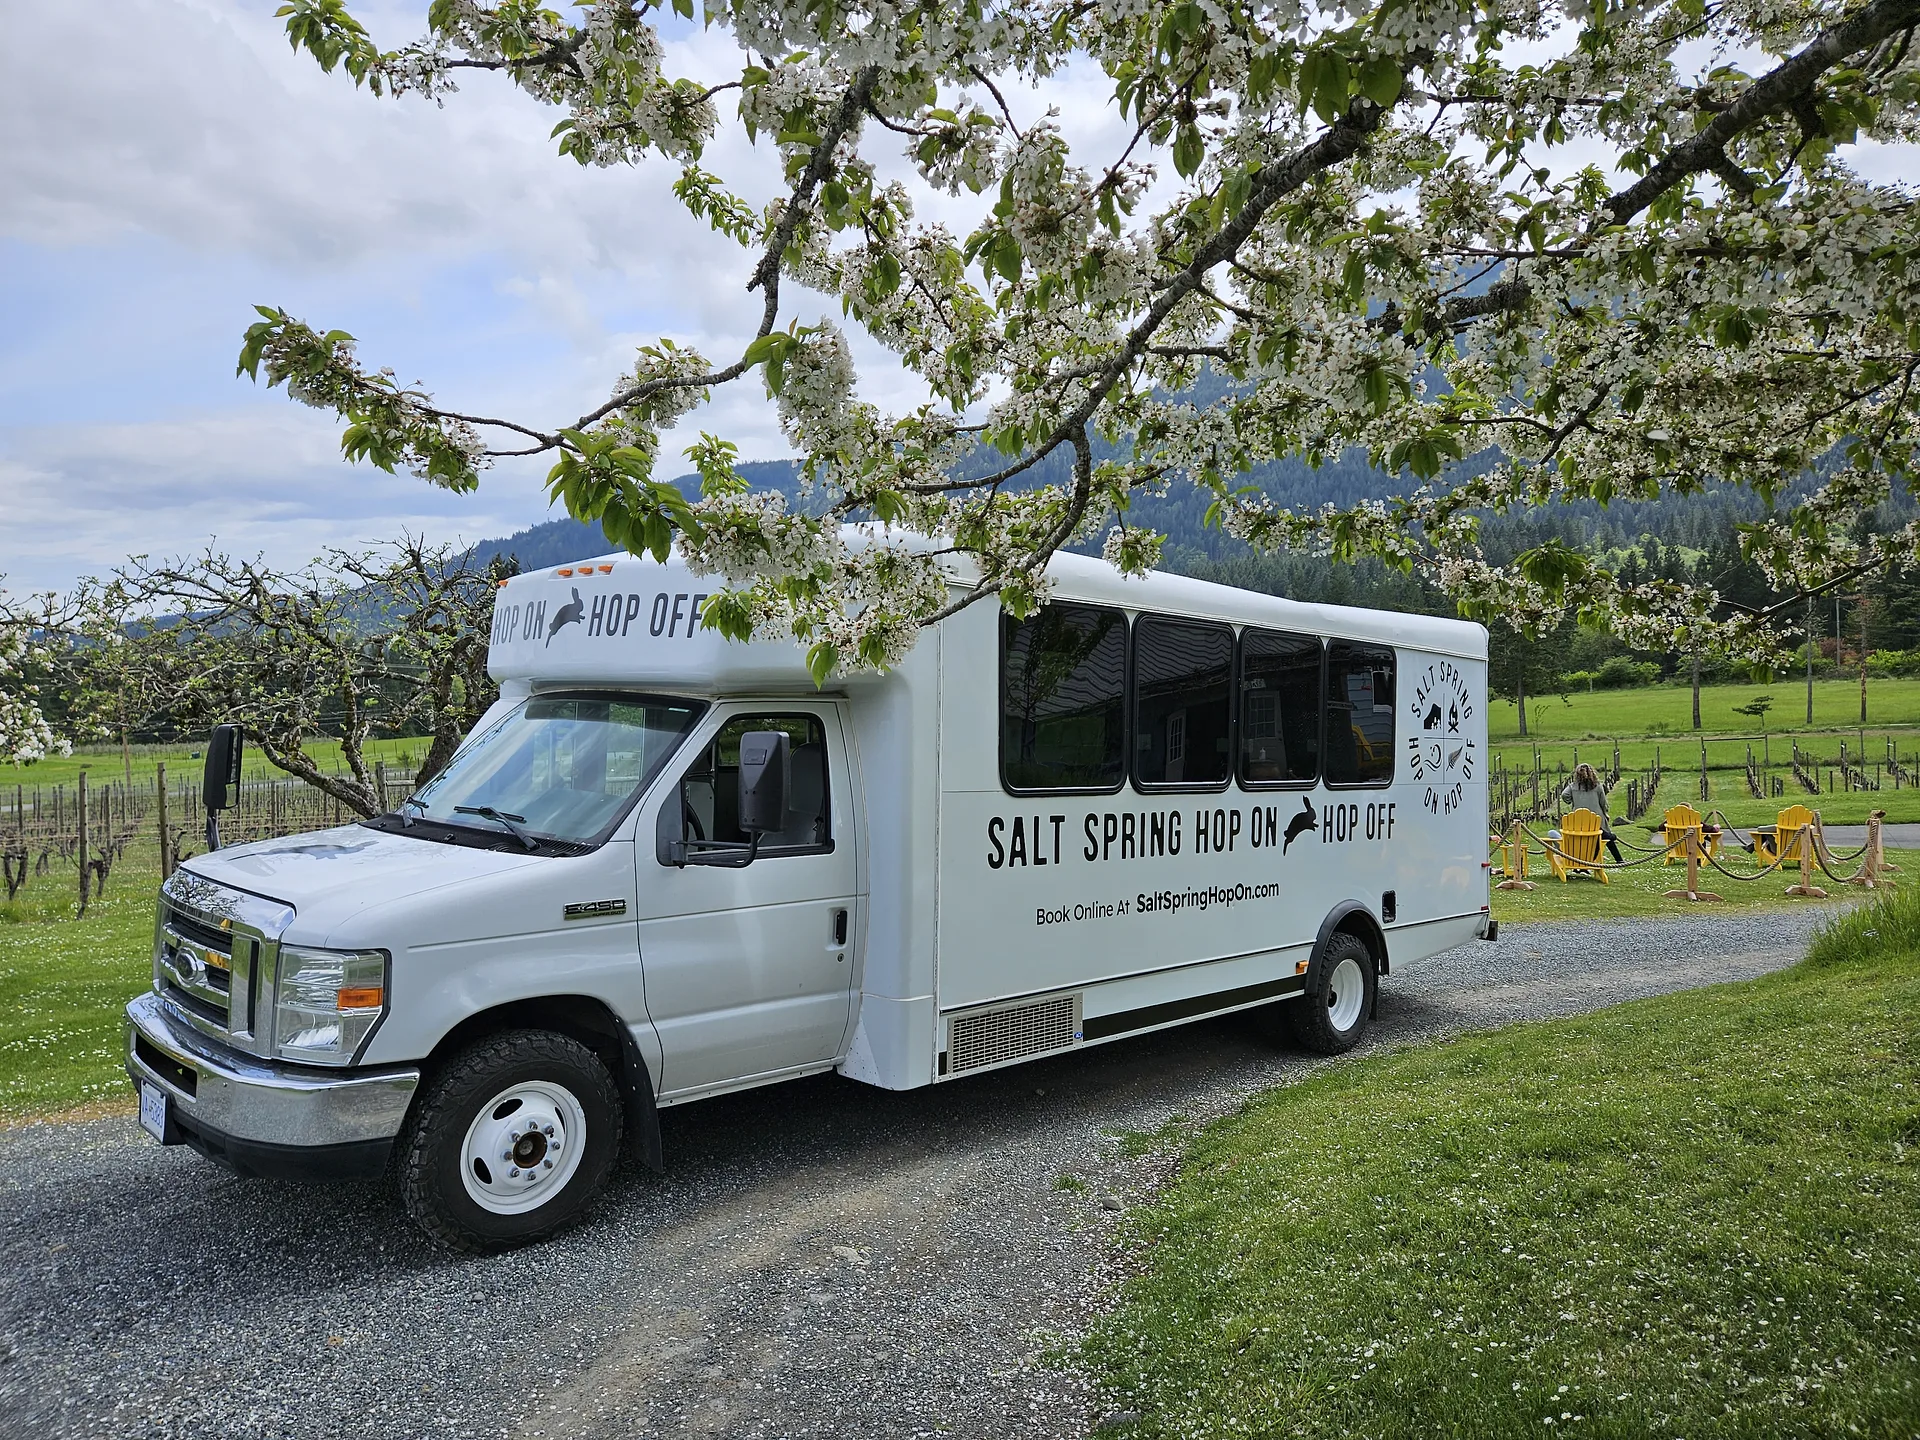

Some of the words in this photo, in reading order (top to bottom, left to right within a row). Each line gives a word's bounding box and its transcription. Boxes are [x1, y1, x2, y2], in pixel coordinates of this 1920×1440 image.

[491, 604, 520, 646] HOP
[522, 599, 547, 641] ON
[587, 593, 641, 637] HOP
[649, 592, 708, 639] OFF
[1411, 665, 1435, 719] SALT
[1439, 660, 1473, 720] SPRING
[1408, 737, 1424, 781] HOP
[1423, 786, 1439, 815] ON
[1443, 782, 1463, 816] HOP
[1462, 738, 1476, 780] OFF
[987, 815, 1066, 870] SALT
[1083, 810, 1182, 862] SPRING
[1195, 808, 1242, 854] HOP
[1251, 806, 1278, 849] ON
[1322, 803, 1359, 843] HOP
[1366, 802, 1396, 841] OFF
[1036, 905, 1071, 926] Book
[1073, 901, 1114, 921] Online
[1116, 899, 1131, 916] At
[1136, 882, 1280, 915] SaltSpringHopOn.com
